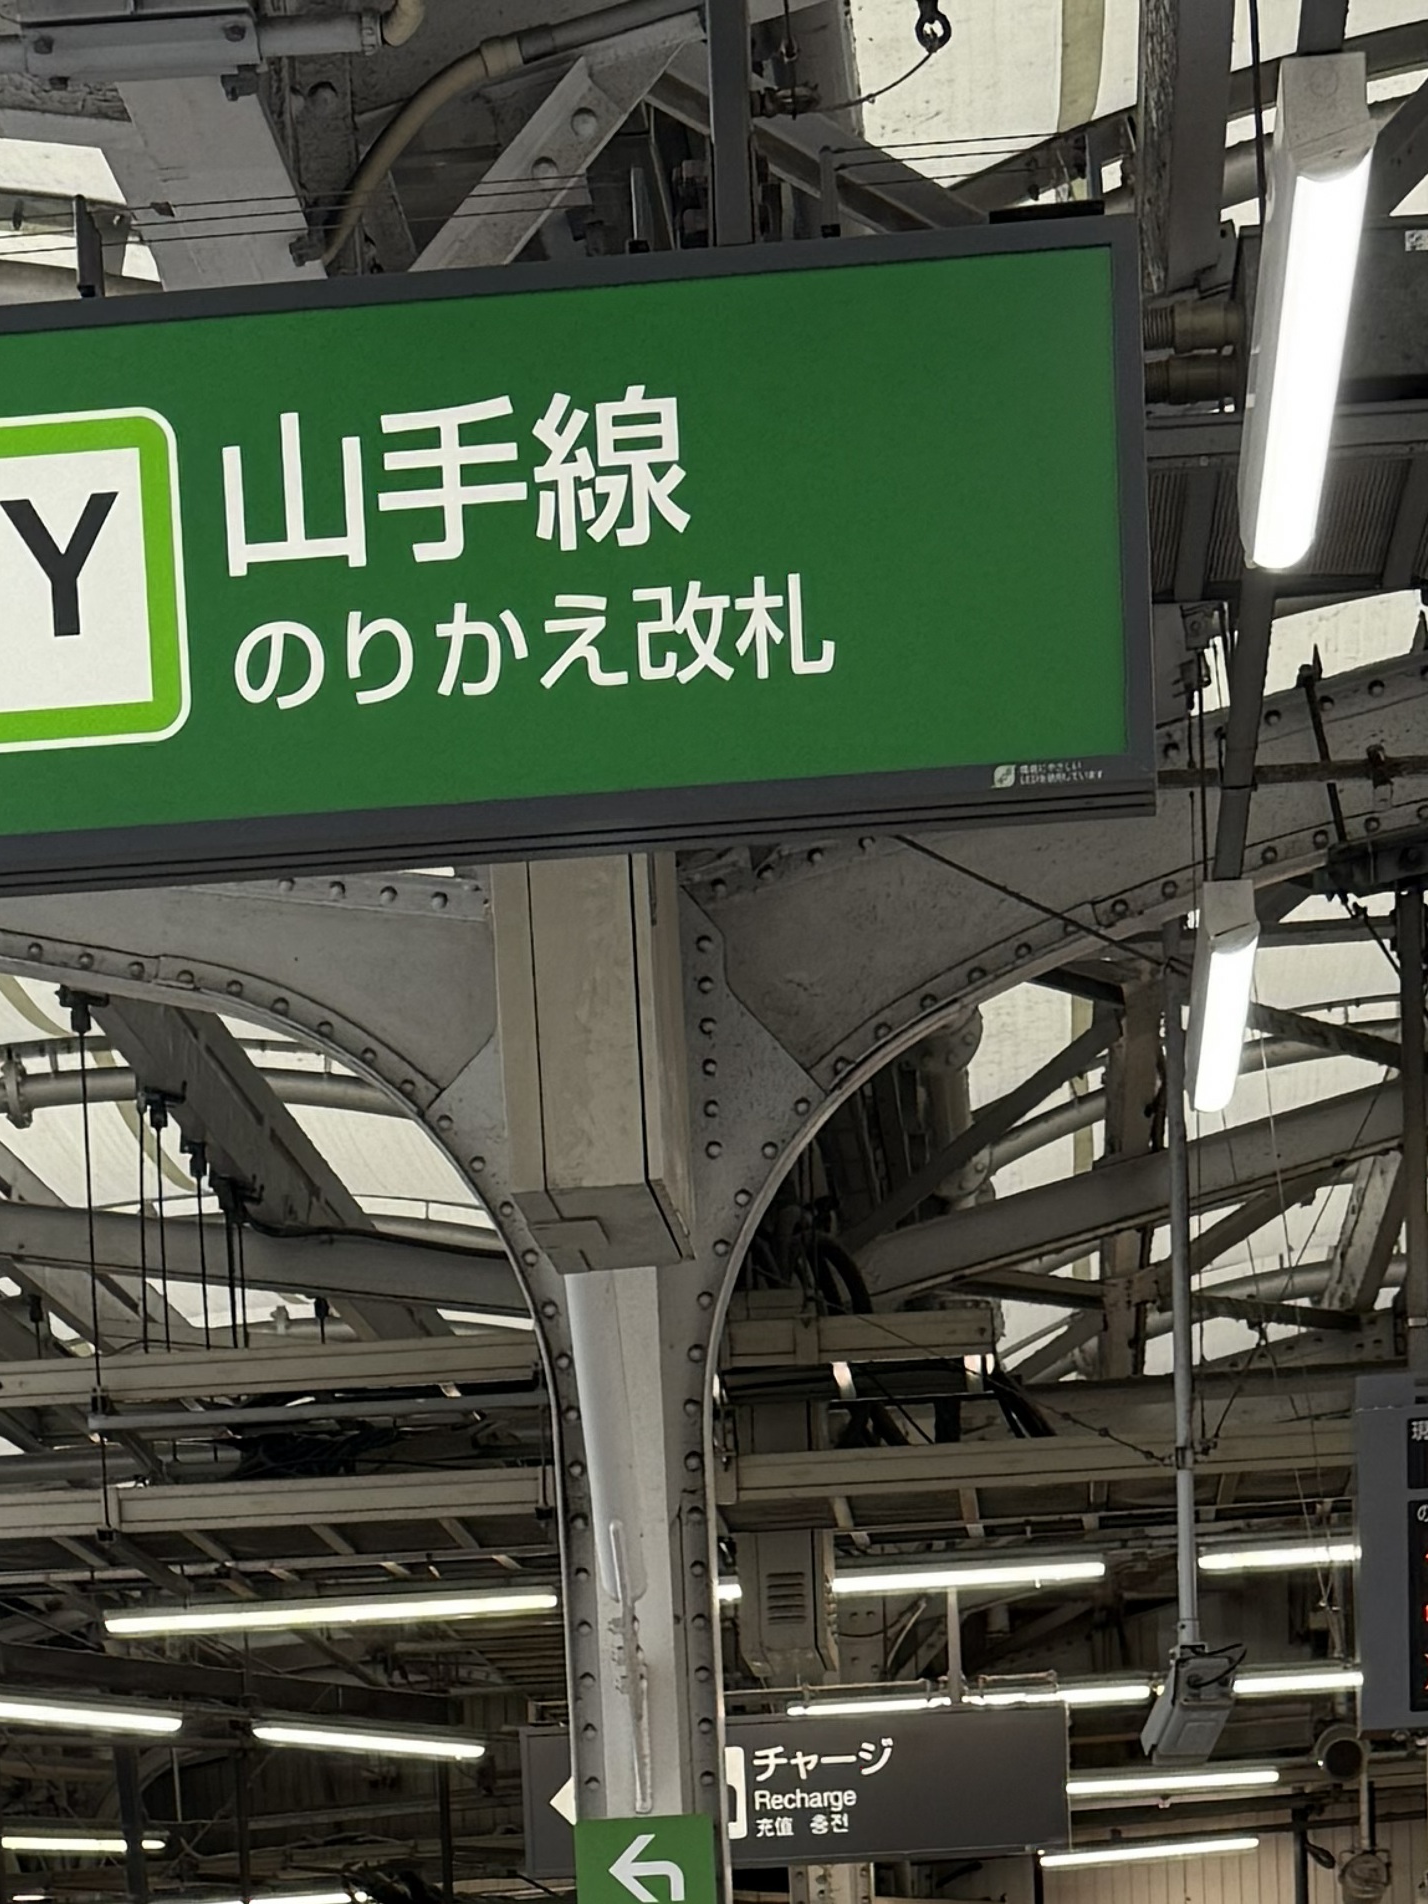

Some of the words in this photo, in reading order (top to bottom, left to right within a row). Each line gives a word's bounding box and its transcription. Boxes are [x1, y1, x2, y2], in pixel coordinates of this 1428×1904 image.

[220, 383, 691, 580] 山手線
[232, 572, 837, 713] のりかえ改札
[753, 1736, 895, 1782] チャージ
[754, 1788, 858, 1812] Recharge
[755, 1816, 795, 1839] 充值
